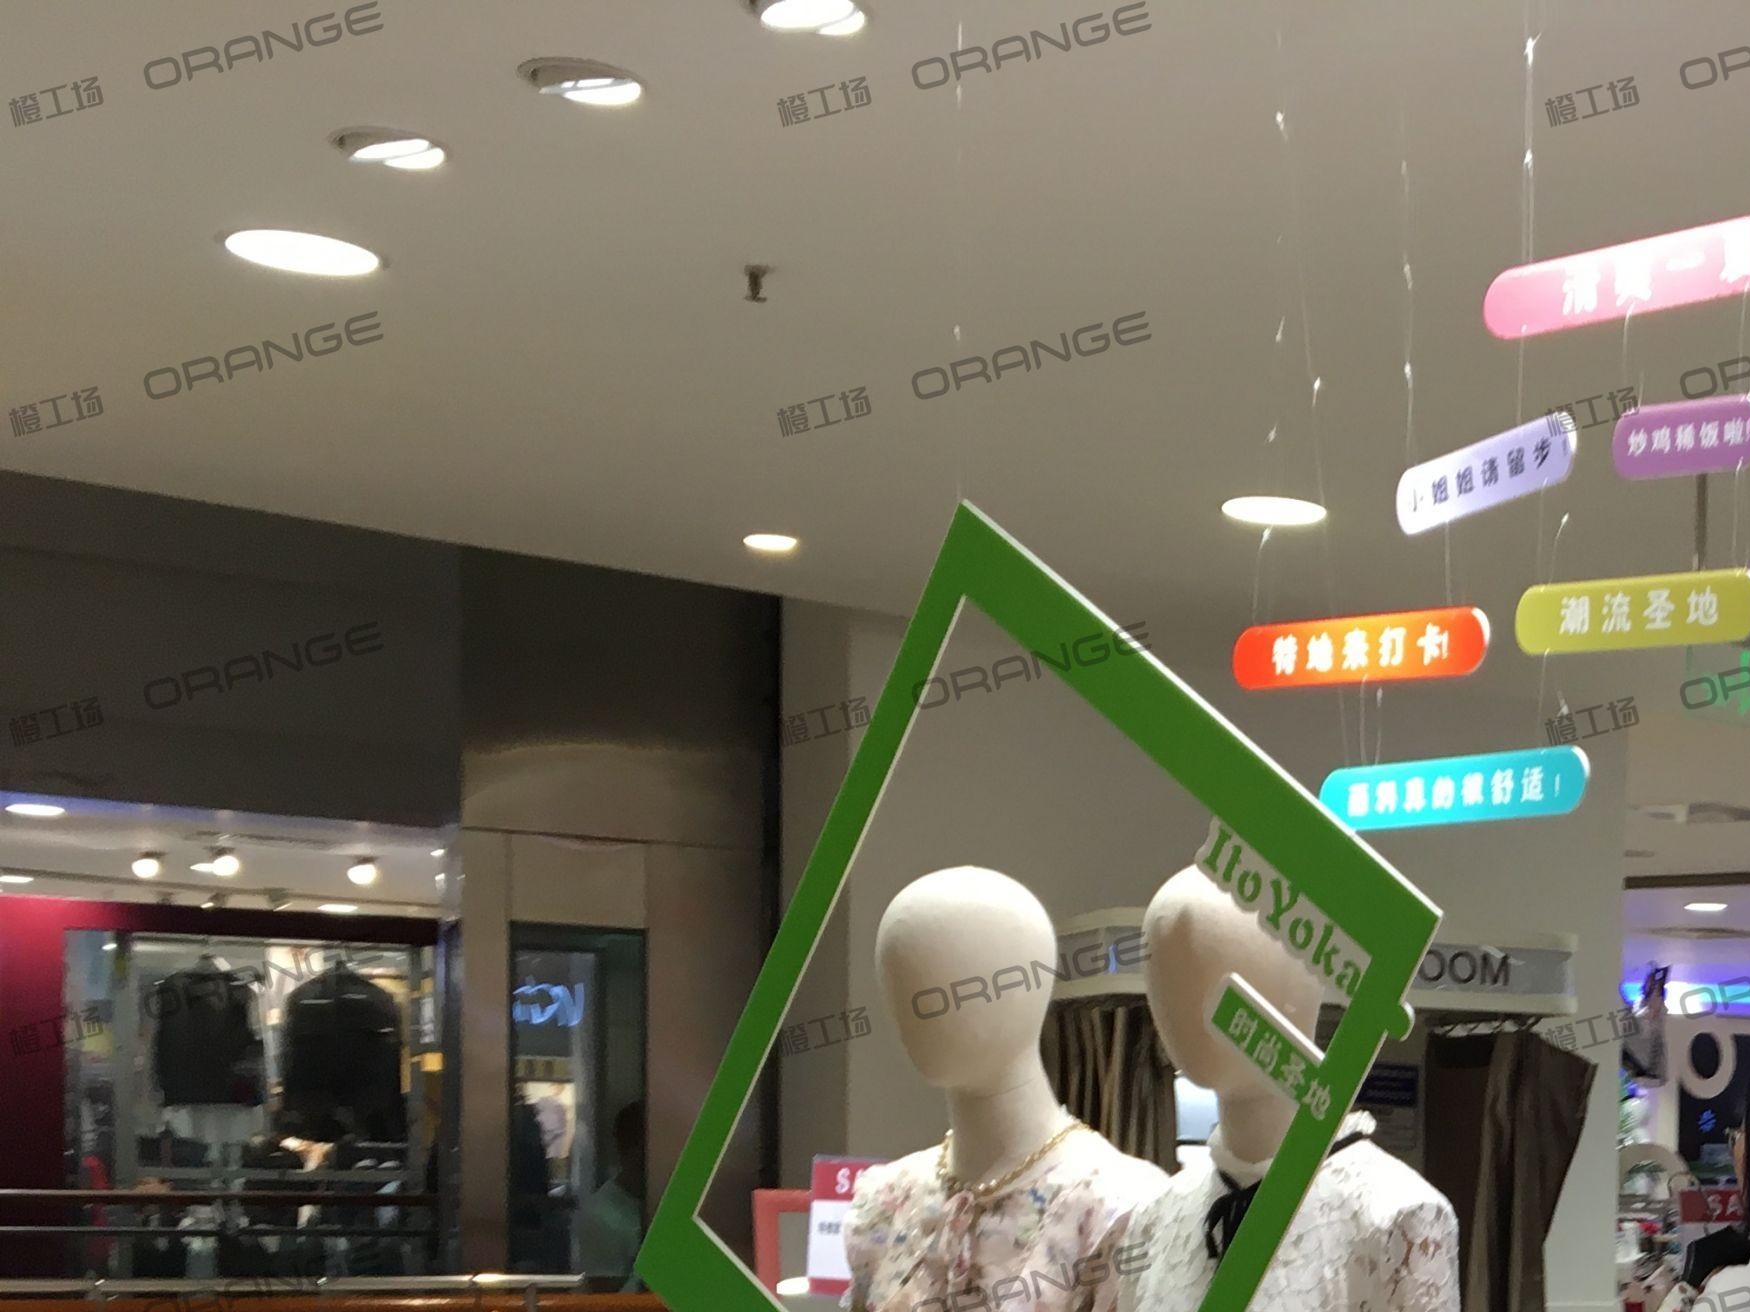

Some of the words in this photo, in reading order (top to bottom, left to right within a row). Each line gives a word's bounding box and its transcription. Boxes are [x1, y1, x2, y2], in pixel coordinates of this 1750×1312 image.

[1559, 587, 1719, 635] 潮流圣地
[1228, 1007, 1332, 1121] 时尚圣地
